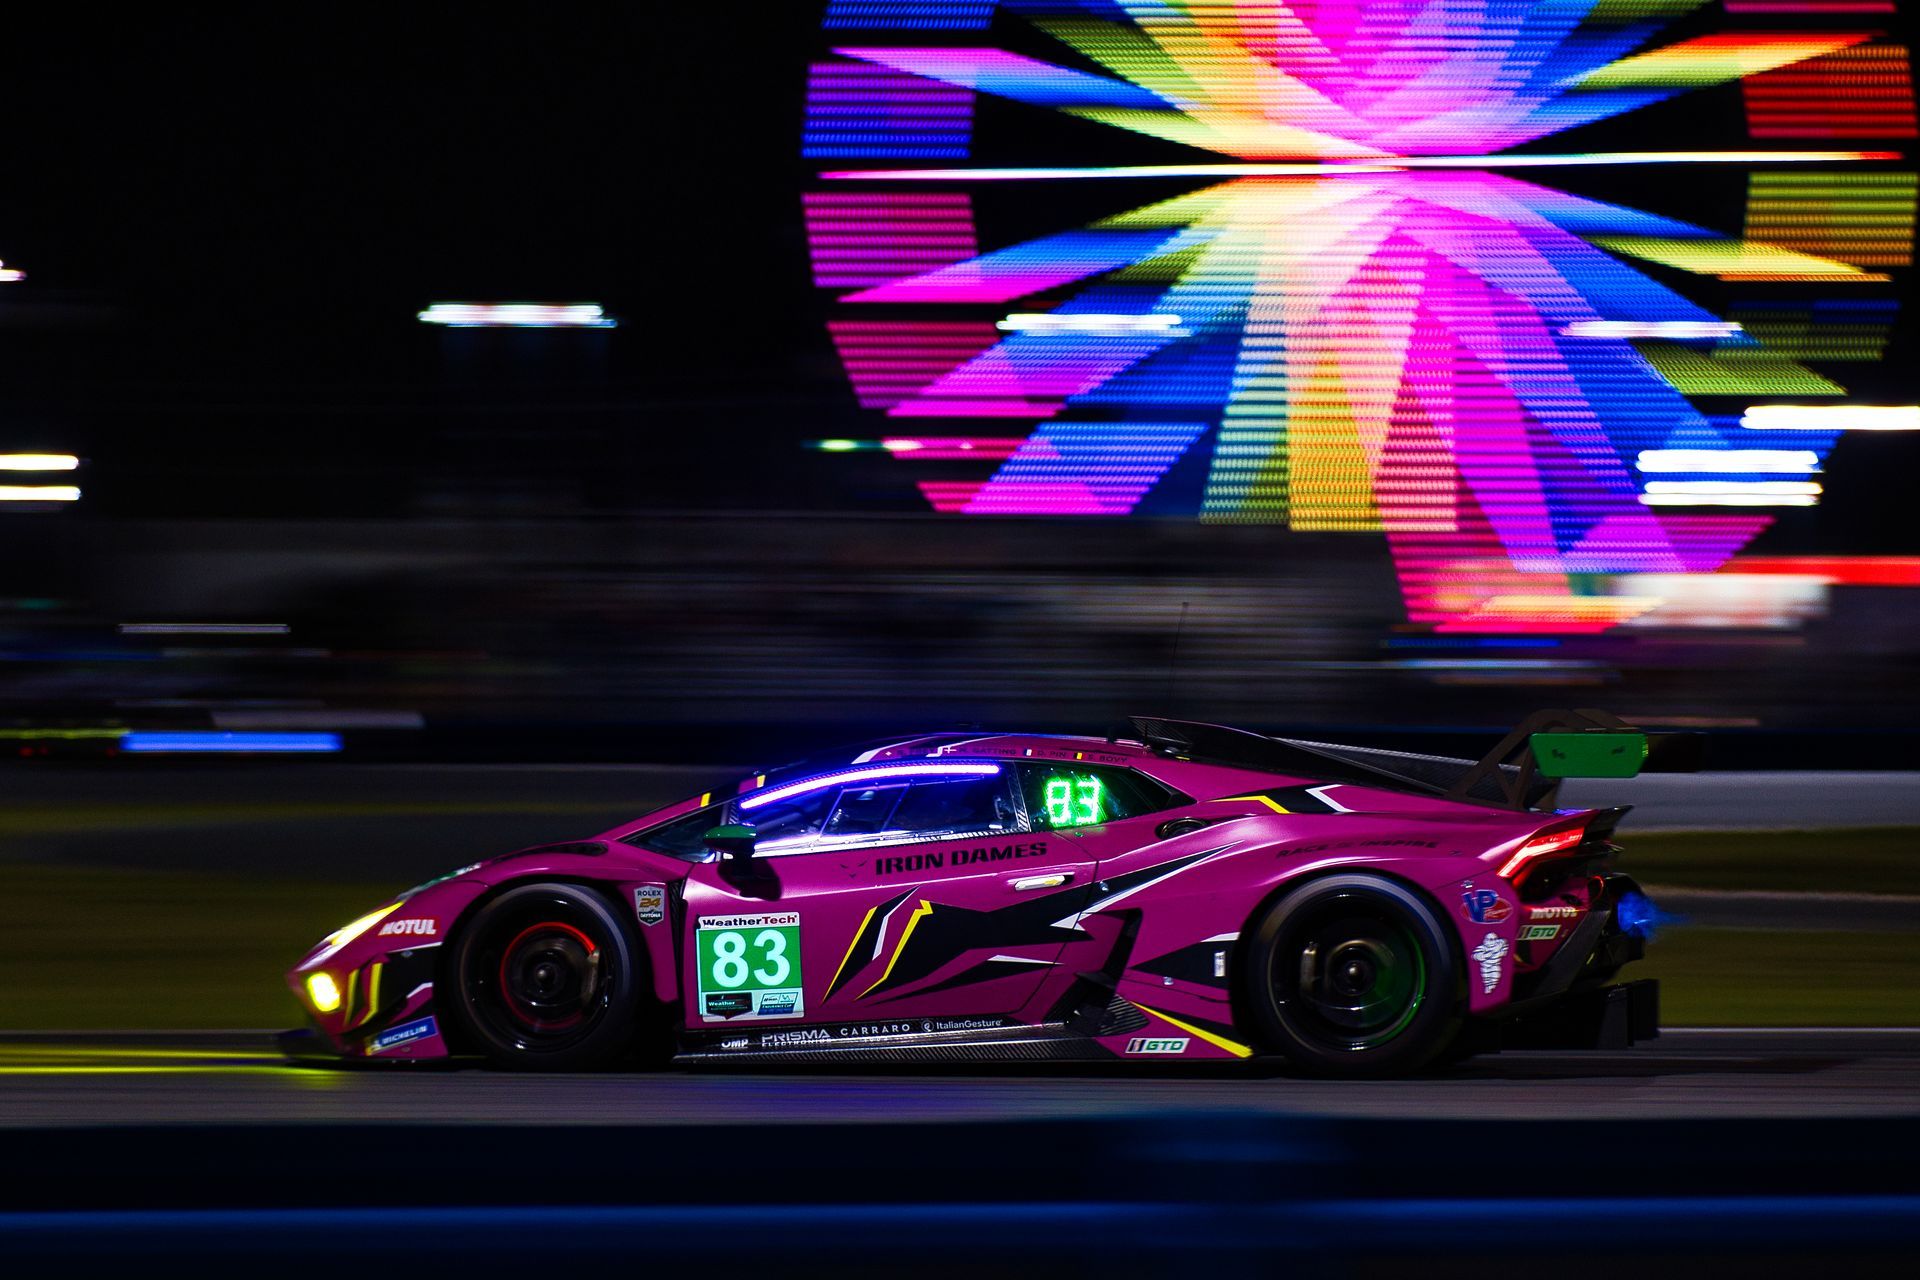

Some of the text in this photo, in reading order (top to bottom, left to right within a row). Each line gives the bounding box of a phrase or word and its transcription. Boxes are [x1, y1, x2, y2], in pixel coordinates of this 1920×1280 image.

[1047, 779, 1101, 824] 83
[875, 842, 1047, 875] IRON DAMES
[639, 898, 661, 908] 24
[377, 919, 438, 936] MOTUL
[702, 915, 797, 927] WeatherTech
[712, 929, 791, 988] 83
[840, 1023, 911, 1036] CARRARO
[936, 1019, 1002, 1031] ItalianGesture
[381, 1024, 429, 1046] MICHELIN
[761, 1028, 831, 1043] PRISMA
[1145, 1040, 1185, 1051] GTD
